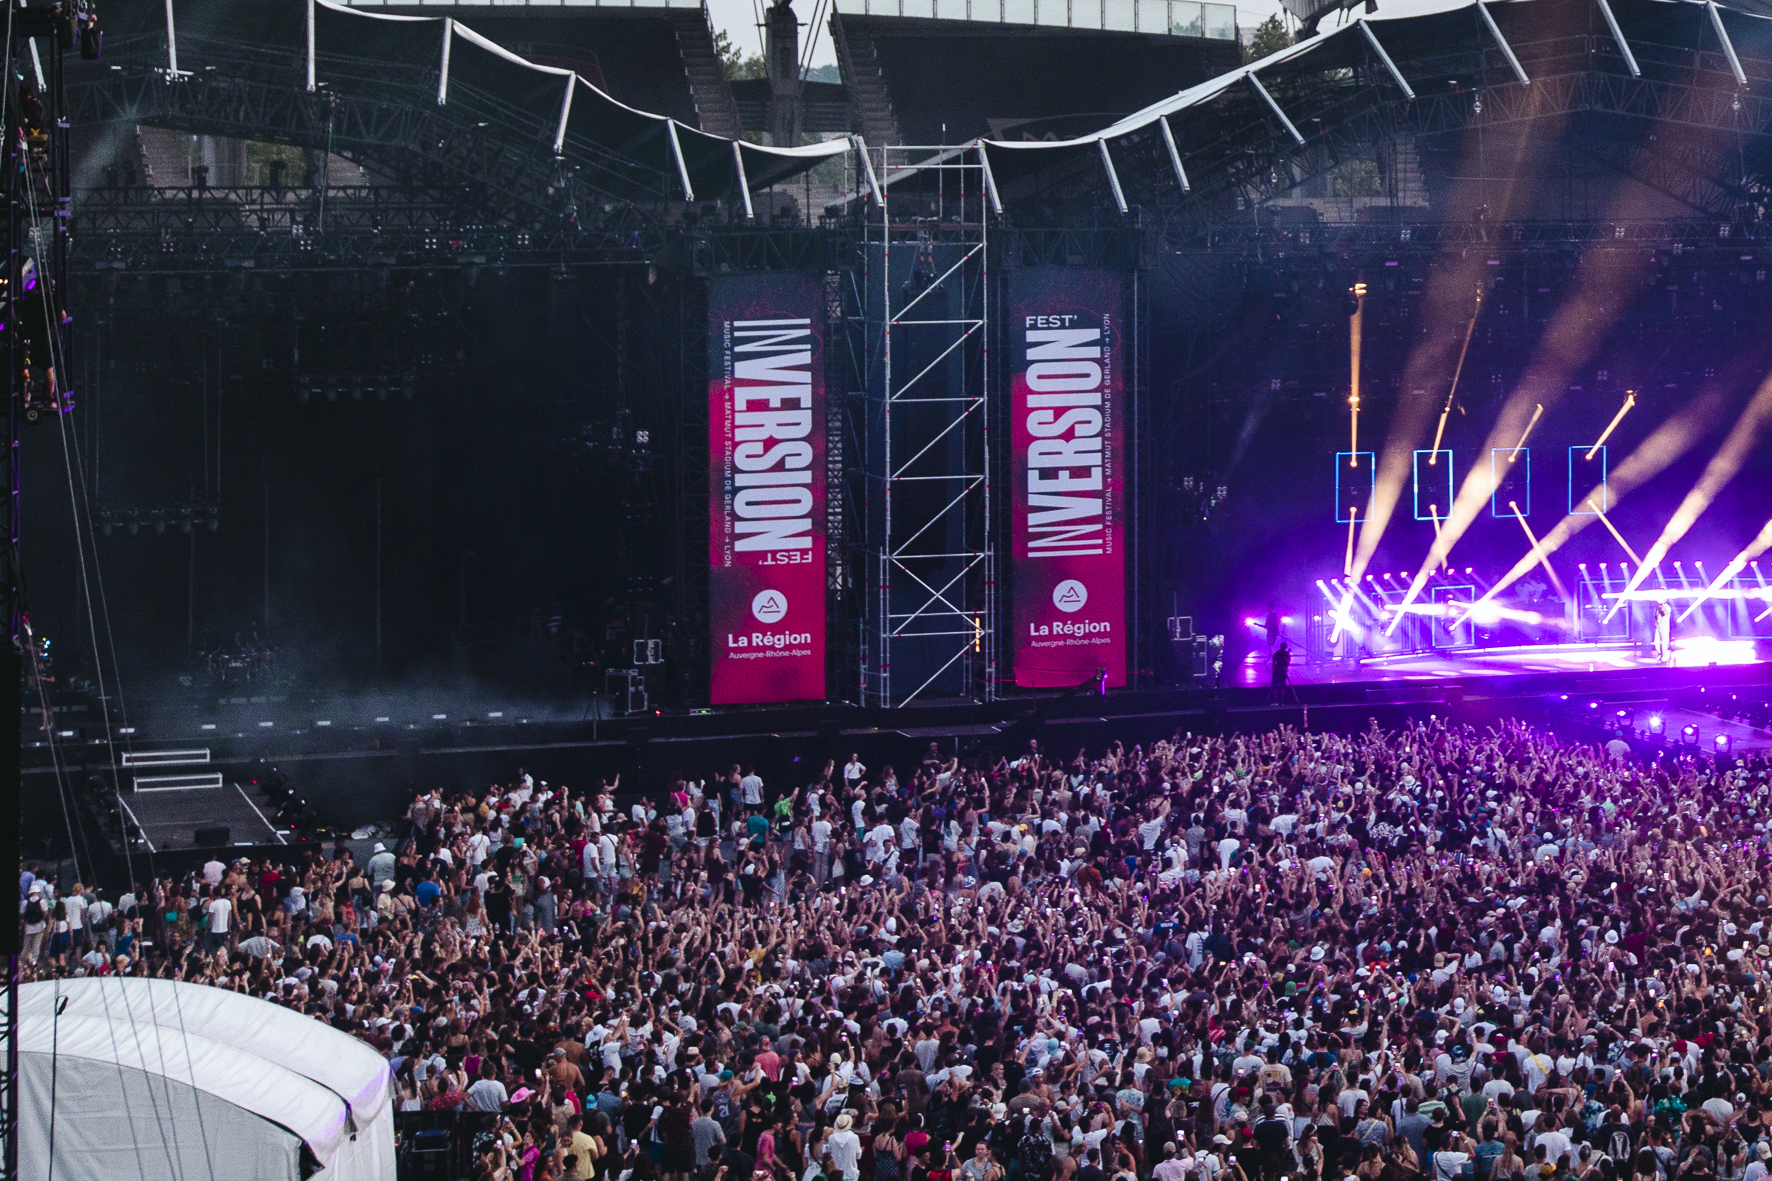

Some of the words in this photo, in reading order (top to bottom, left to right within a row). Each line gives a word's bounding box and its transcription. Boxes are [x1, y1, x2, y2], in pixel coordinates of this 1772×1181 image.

[723, 320, 731, 348] MUSIC
[1103, 313, 1111, 335] LYON
[723, 350, 732, 390] FESTIVAL
[1103, 346, 1111, 386] GERLAND
[1104, 388, 1112, 399] DE
[724, 401, 732, 439] MATMUT
[1104, 400, 1112, 437] STADIUM
[733, 318, 813, 552] INVERSION
[1026, 328, 1103, 557] INVERSION
[724, 440, 732, 478] STADIUM
[1104, 439, 1112, 476] MATMUT
[724, 480, 732, 492] DE
[724, 493, 732, 534] GERLAND
[1105, 486, 1113, 525] FESTIVAL
[724, 544, 732, 567] LYON
[1105, 527, 1113, 554] MUSIC
[728, 633, 748, 647] La
[752, 630, 812, 649] Région
[1030, 622, 1049, 636] La
[1053, 620, 1111, 637] Région
[1030, 637, 1111, 648] Auvergne-Rhône-Alpes
[729, 649, 811, 660] Auvergne-Rhône-Alpes
